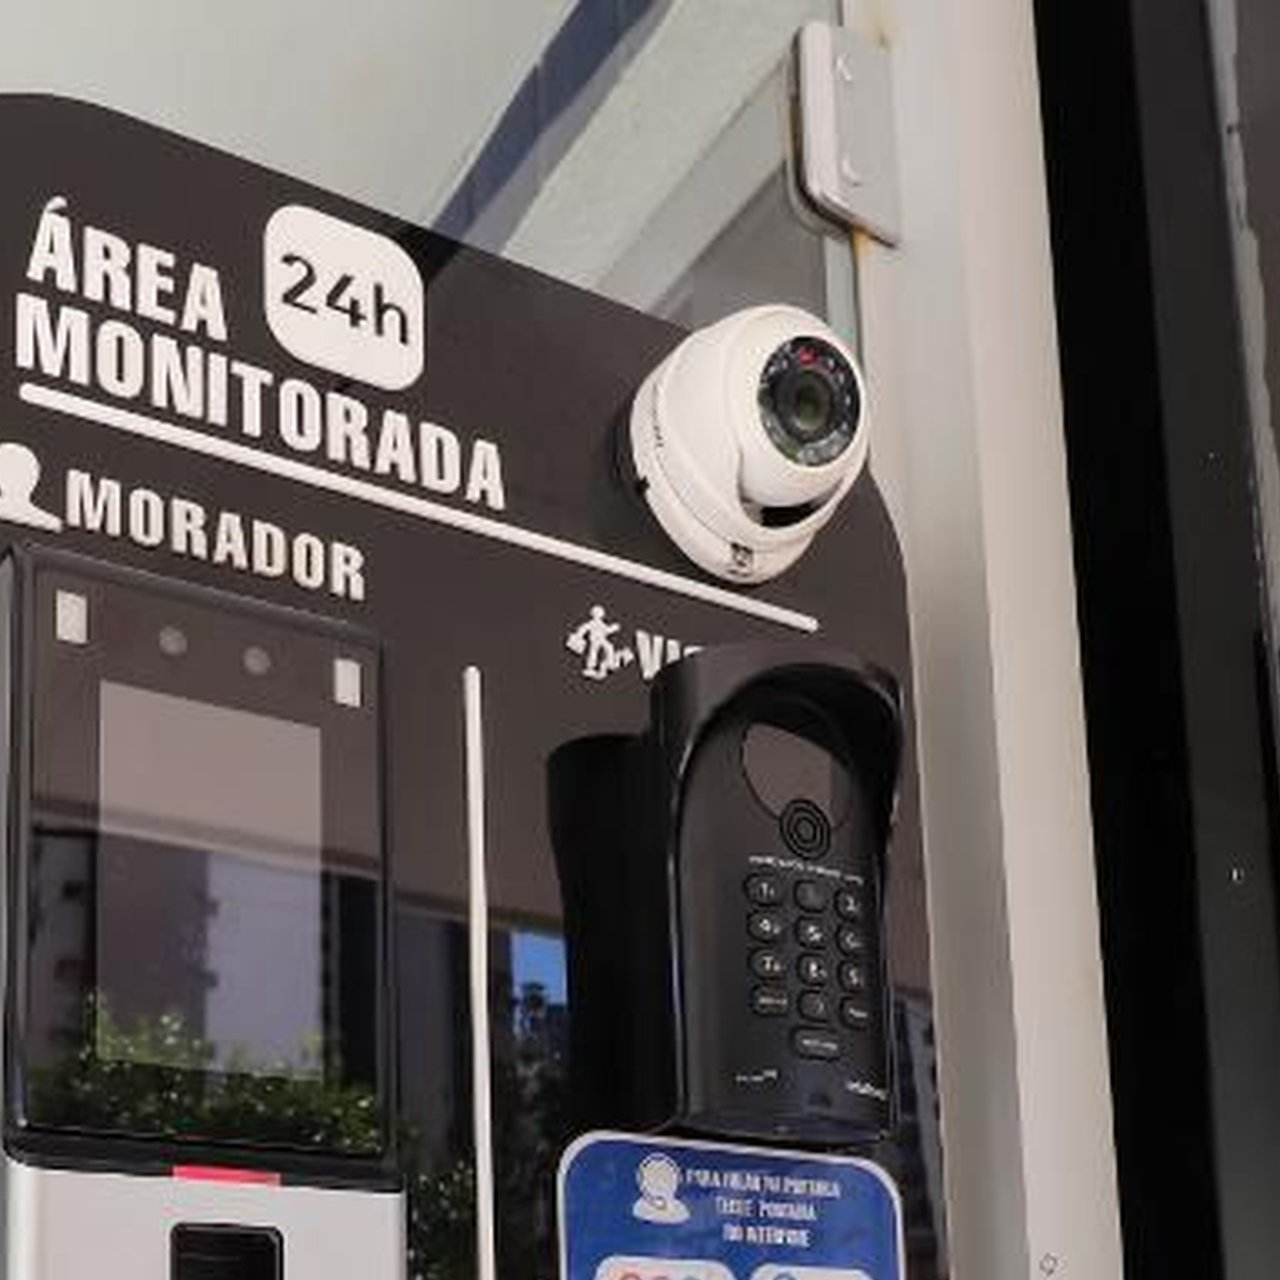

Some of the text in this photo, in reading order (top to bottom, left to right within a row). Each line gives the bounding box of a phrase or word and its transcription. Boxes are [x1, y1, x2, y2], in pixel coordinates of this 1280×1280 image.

[26, 196, 228, 341] ÁREA
[280, 252, 410, 345] 24h
[16, 291, 506, 510] MONITORADA
[65, 469, 366, 601] MORADOR
